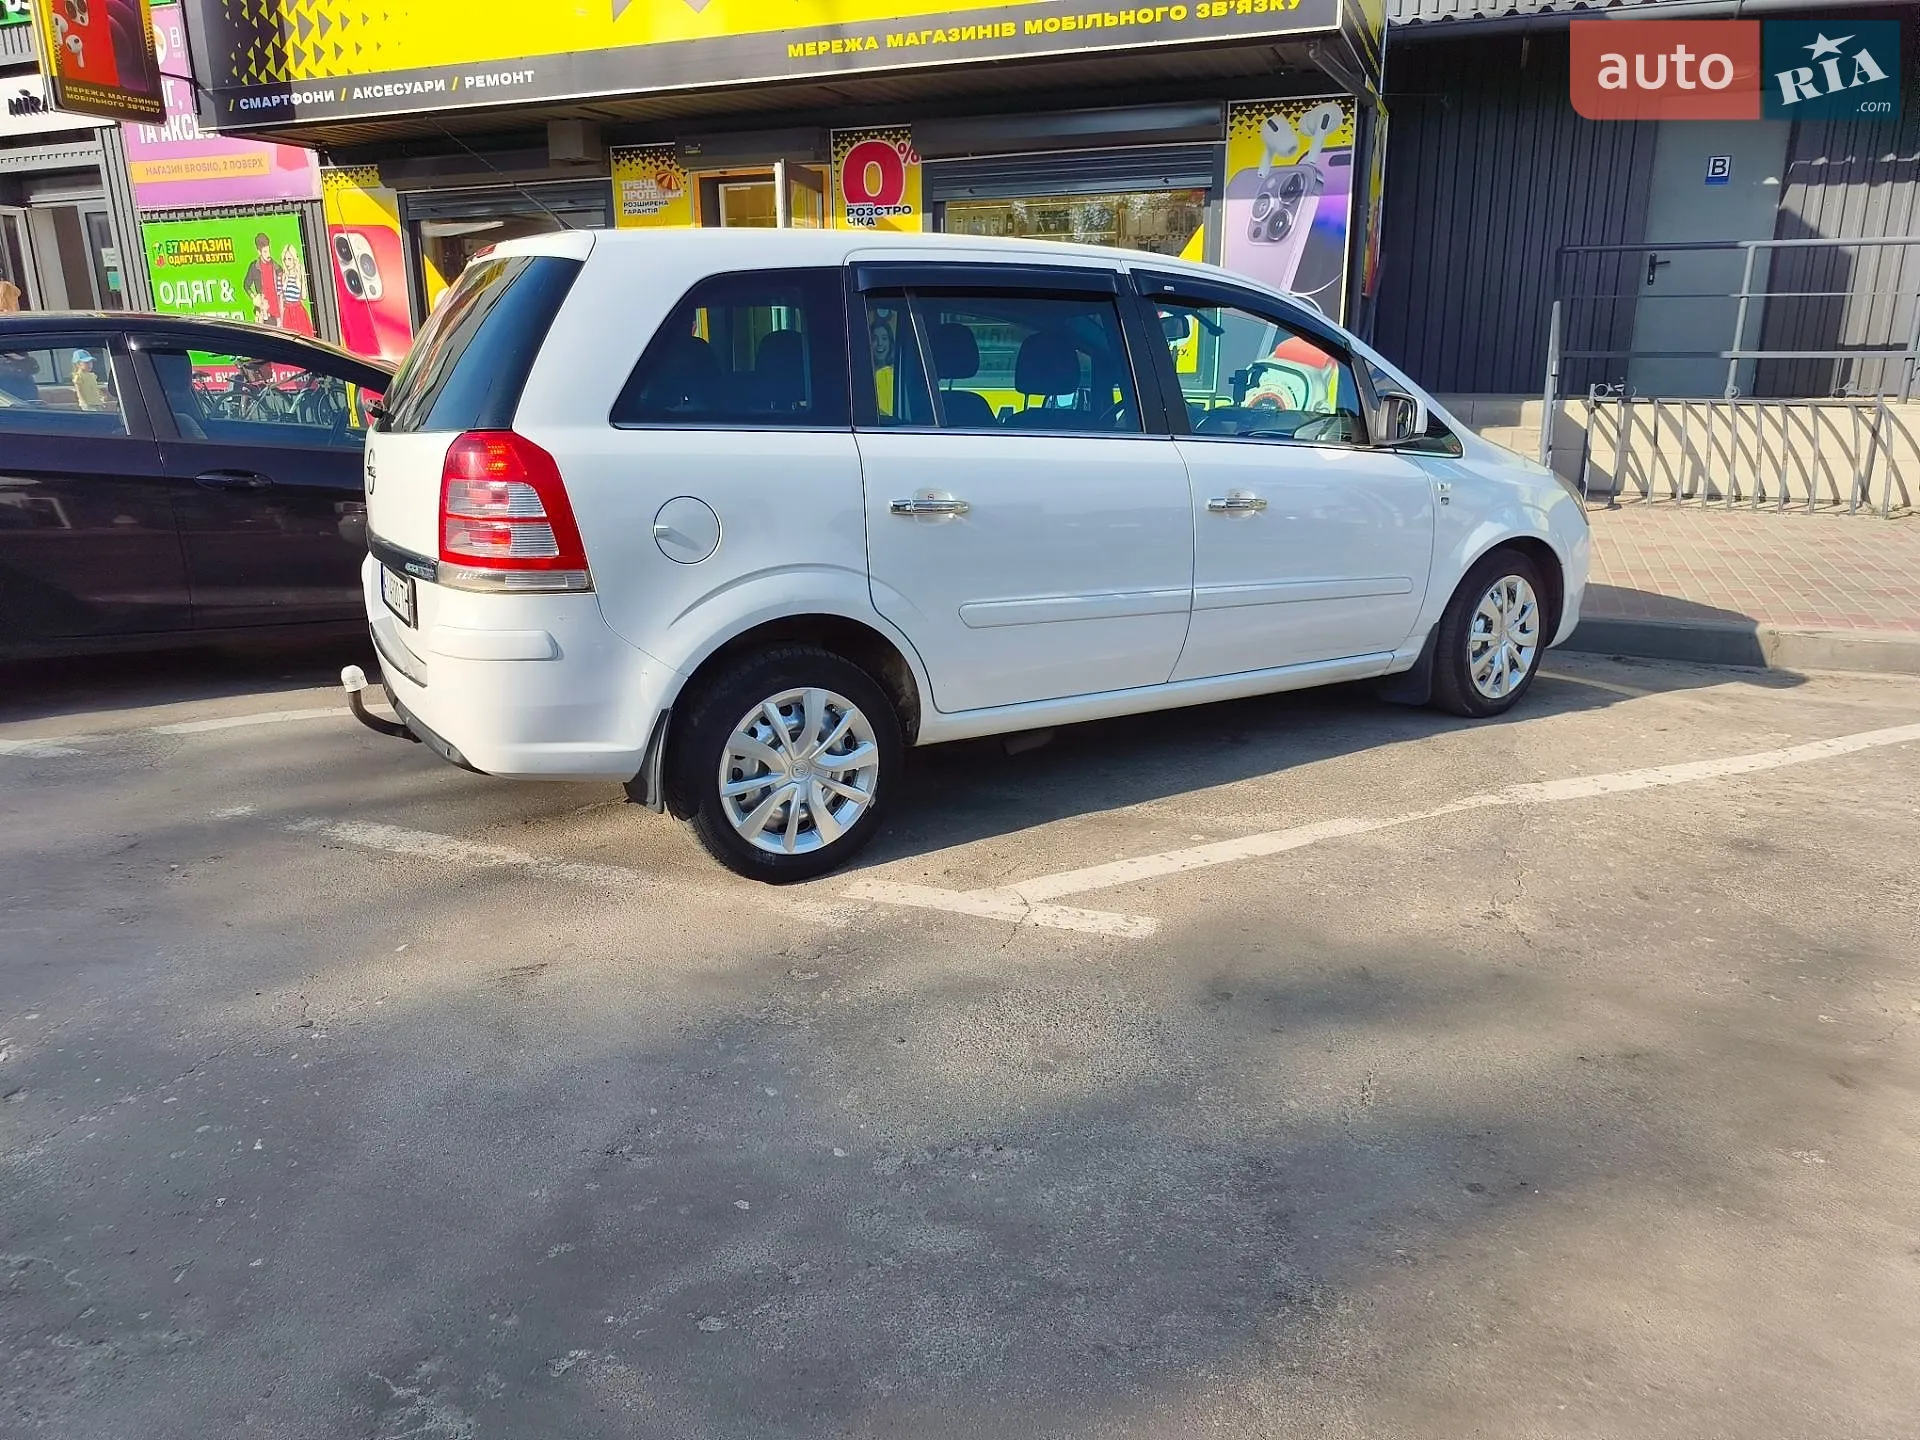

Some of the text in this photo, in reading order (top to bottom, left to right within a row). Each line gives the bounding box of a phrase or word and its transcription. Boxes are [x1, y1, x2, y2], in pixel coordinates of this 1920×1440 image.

[788, 36, 880, 58] МЕРЕЖА
[886, 22, 1016, 48] МАГАЗИНІВ
[1024, 5, 1188, 35] МОБІЛЬНОГО
[65, 85, 106, 97] МЕРЕЖА
[108, 92, 160, 106] МАГАЗИНІВ
[239, 90, 335, 110] СМАРТФОНИ
[352, 79, 446, 99] АКСЕСУАРИ
[464, 70, 535, 89] РЕМОНТ
[66, 93, 125, 107] МОБІЛЬНОГО
[623, 200, 669, 209] РОЗШИРЕНА
[846, 205, 912, 217] РОЗСТРО
[846, 216, 876, 226] ЧКА
[179, 238, 232, 253] МАГАЗИН
[168, 252, 234, 266] ОДЯГУ ТА ВЗУТТЯ
[159, 279, 218, 309] ОДЯГ
